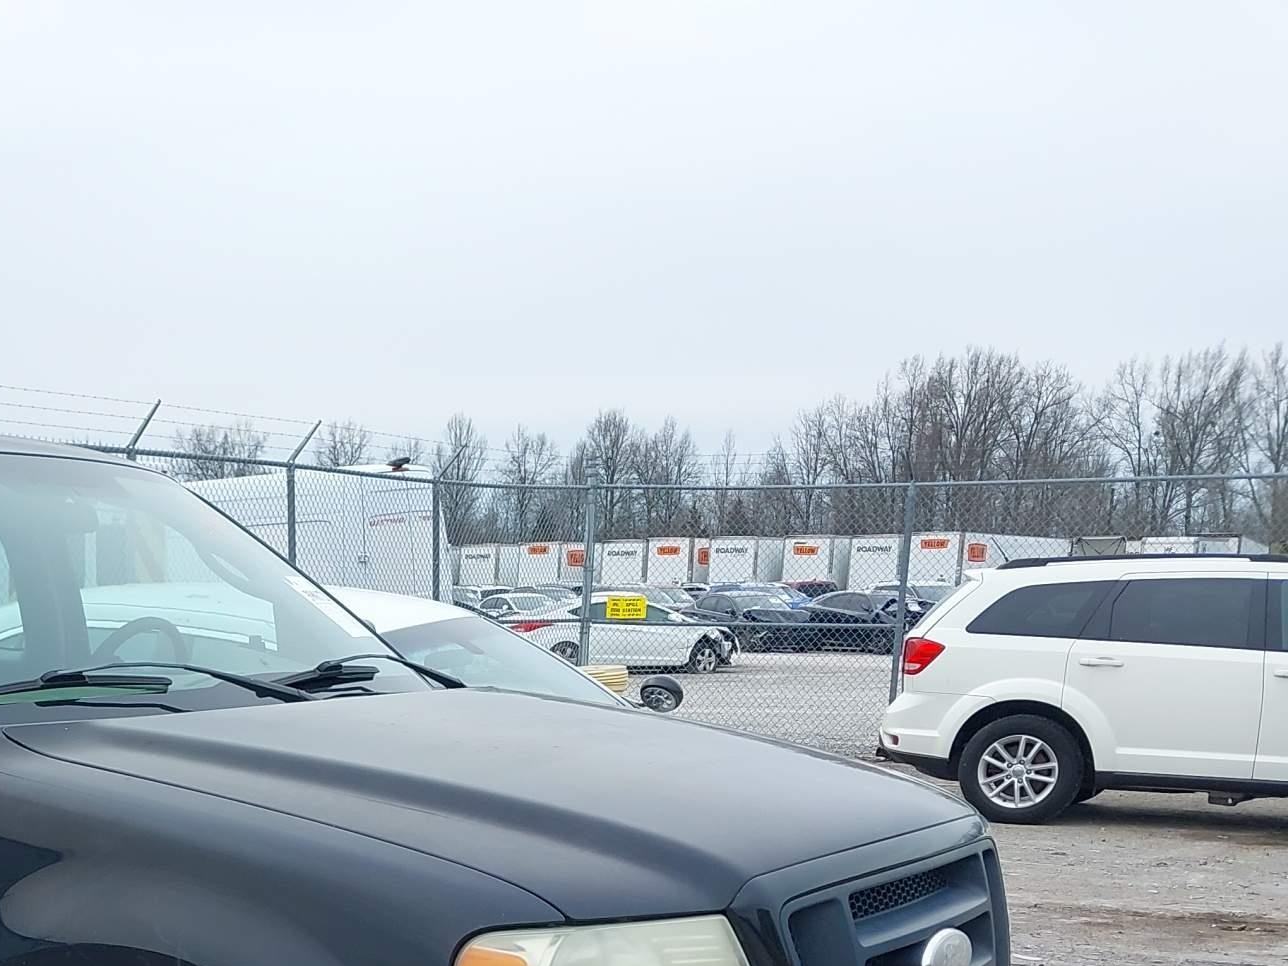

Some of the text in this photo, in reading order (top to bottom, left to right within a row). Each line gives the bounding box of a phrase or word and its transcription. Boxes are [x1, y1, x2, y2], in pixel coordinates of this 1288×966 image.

[607, 549, 638, 557] ROADWAY
[716, 546, 748, 554] ROADWAY
[856, 545, 893, 553] ROADWAY
